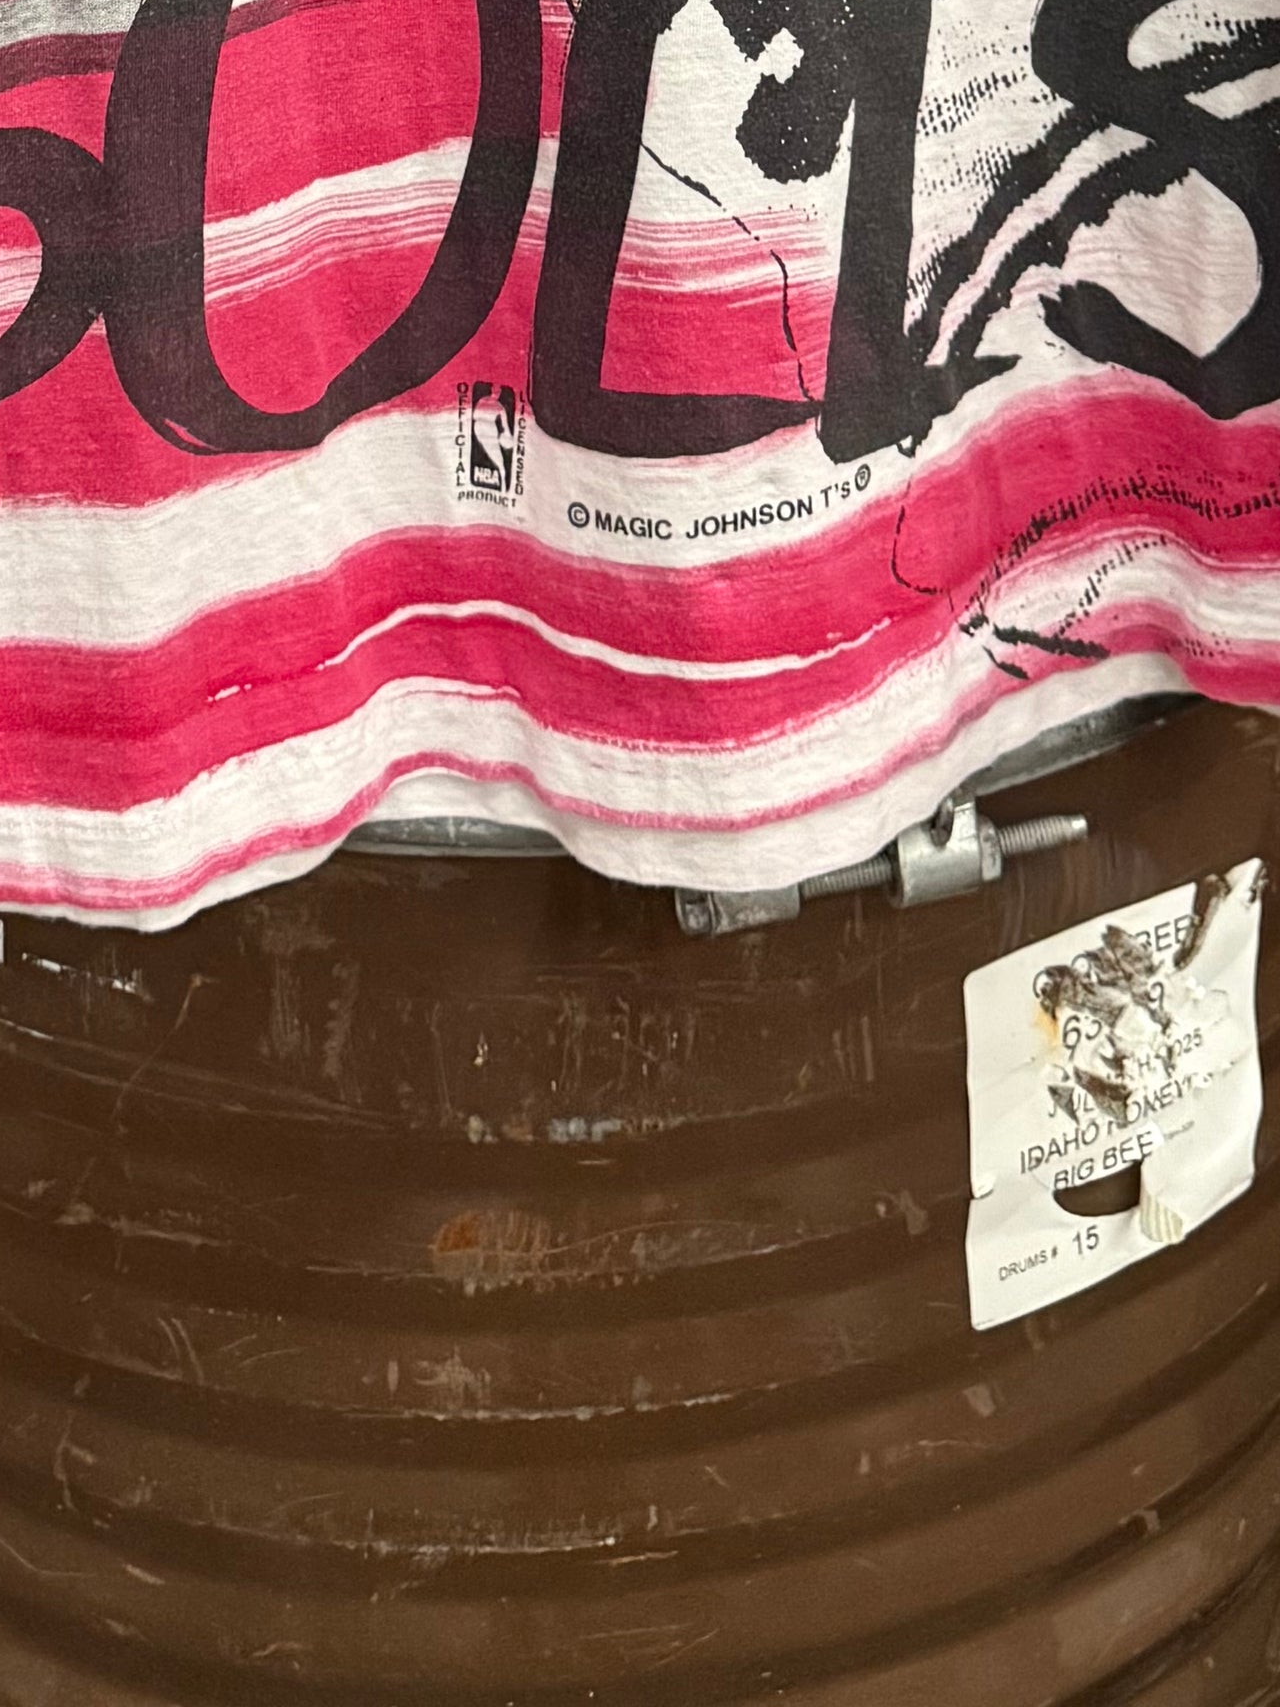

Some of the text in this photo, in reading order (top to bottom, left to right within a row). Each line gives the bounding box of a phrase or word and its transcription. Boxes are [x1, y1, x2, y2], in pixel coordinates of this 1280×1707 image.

[455, 381, 469, 487] OFFICIAL
[514, 390, 527, 496] LICENSED
[457, 490, 517, 508] PRODUCT
[685, 495, 814, 539] JOHNSON
[1020, 1120, 1102, 1175] IDAHO
[1053, 1158, 1095, 1191] BIG
[1102, 1130, 1153, 1171] BEE
[998, 1249, 1048, 1282] DRUMS
[1071, 1224, 1100, 1256] 15
